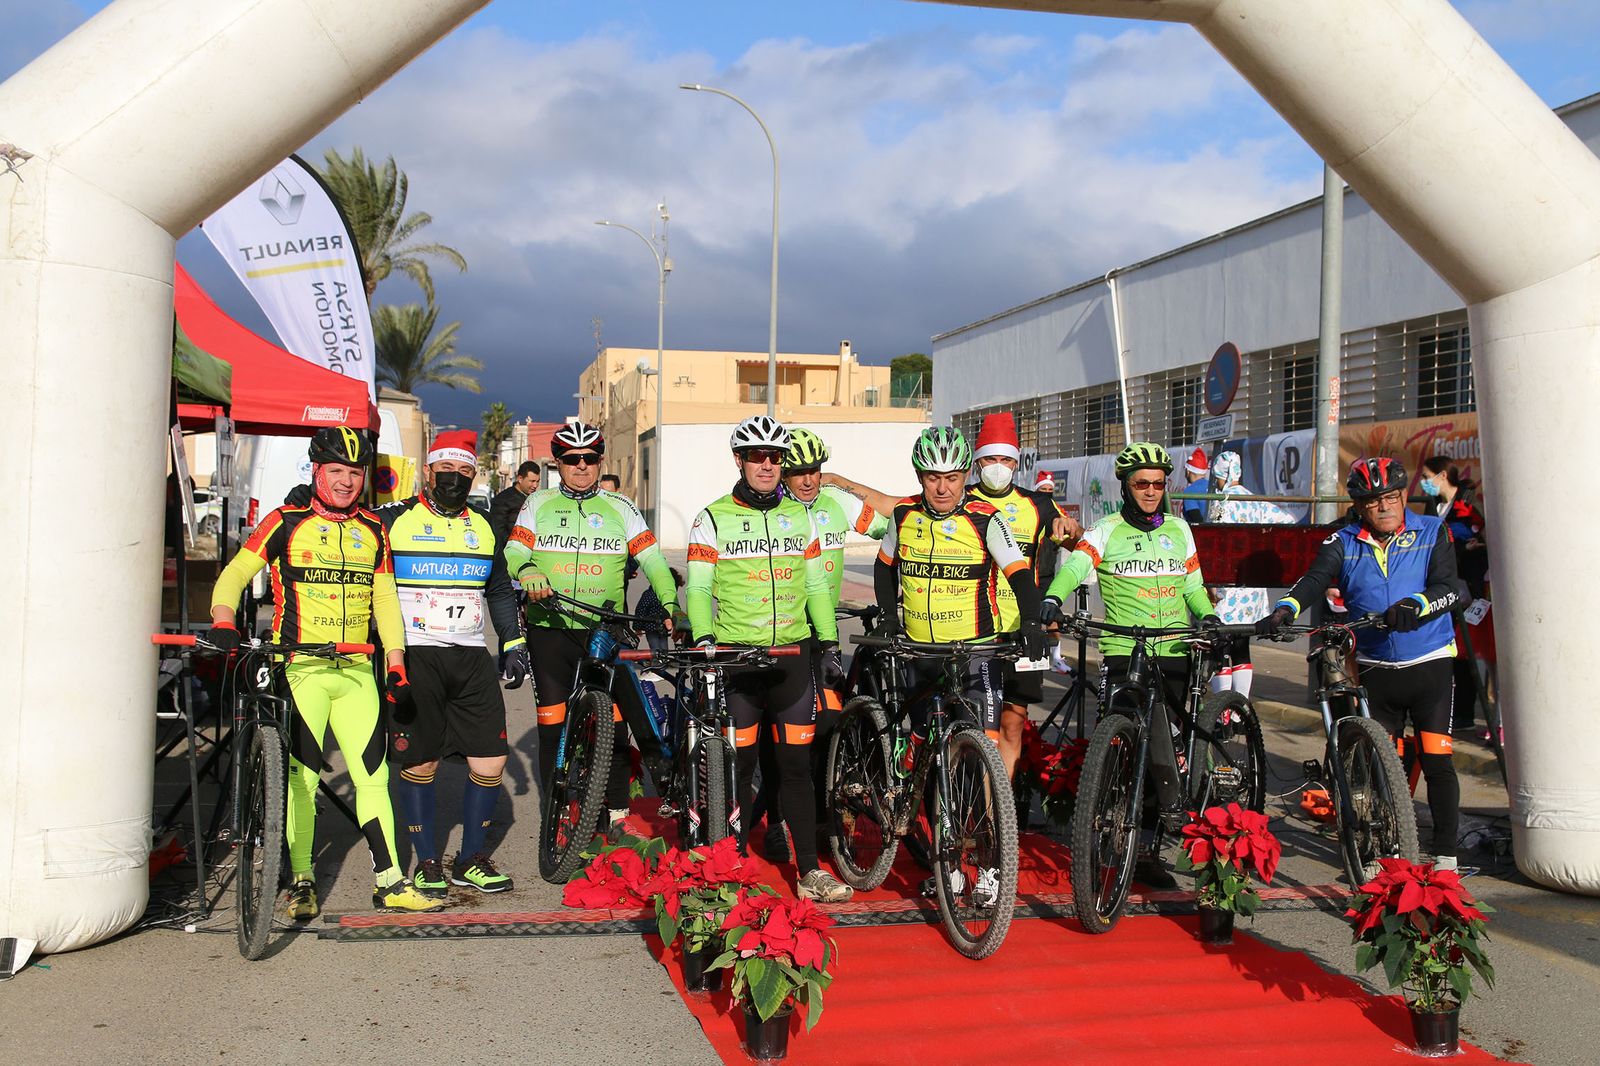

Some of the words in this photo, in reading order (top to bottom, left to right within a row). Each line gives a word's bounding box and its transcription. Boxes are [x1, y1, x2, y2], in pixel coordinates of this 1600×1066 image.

[537, 534, 587, 550] NATURA
[593, 537, 621, 551] BIKE
[725, 538, 779, 556] NATURA
[784, 537, 804, 552] BIKE
[412, 562, 459, 575] NATURA
[463, 563, 487, 577] BIKE
[551, 562, 603, 576] AGRO
[747, 567, 793, 581] AGRO
[901, 562, 939, 577] NATURA
[943, 565, 970, 578] BIKE
[1115, 558, 1164, 575] NATURA
[304, 569, 350, 584] NATURA
[1136, 586, 1177, 599] AGRO
[445, 605, 465, 618] 17
